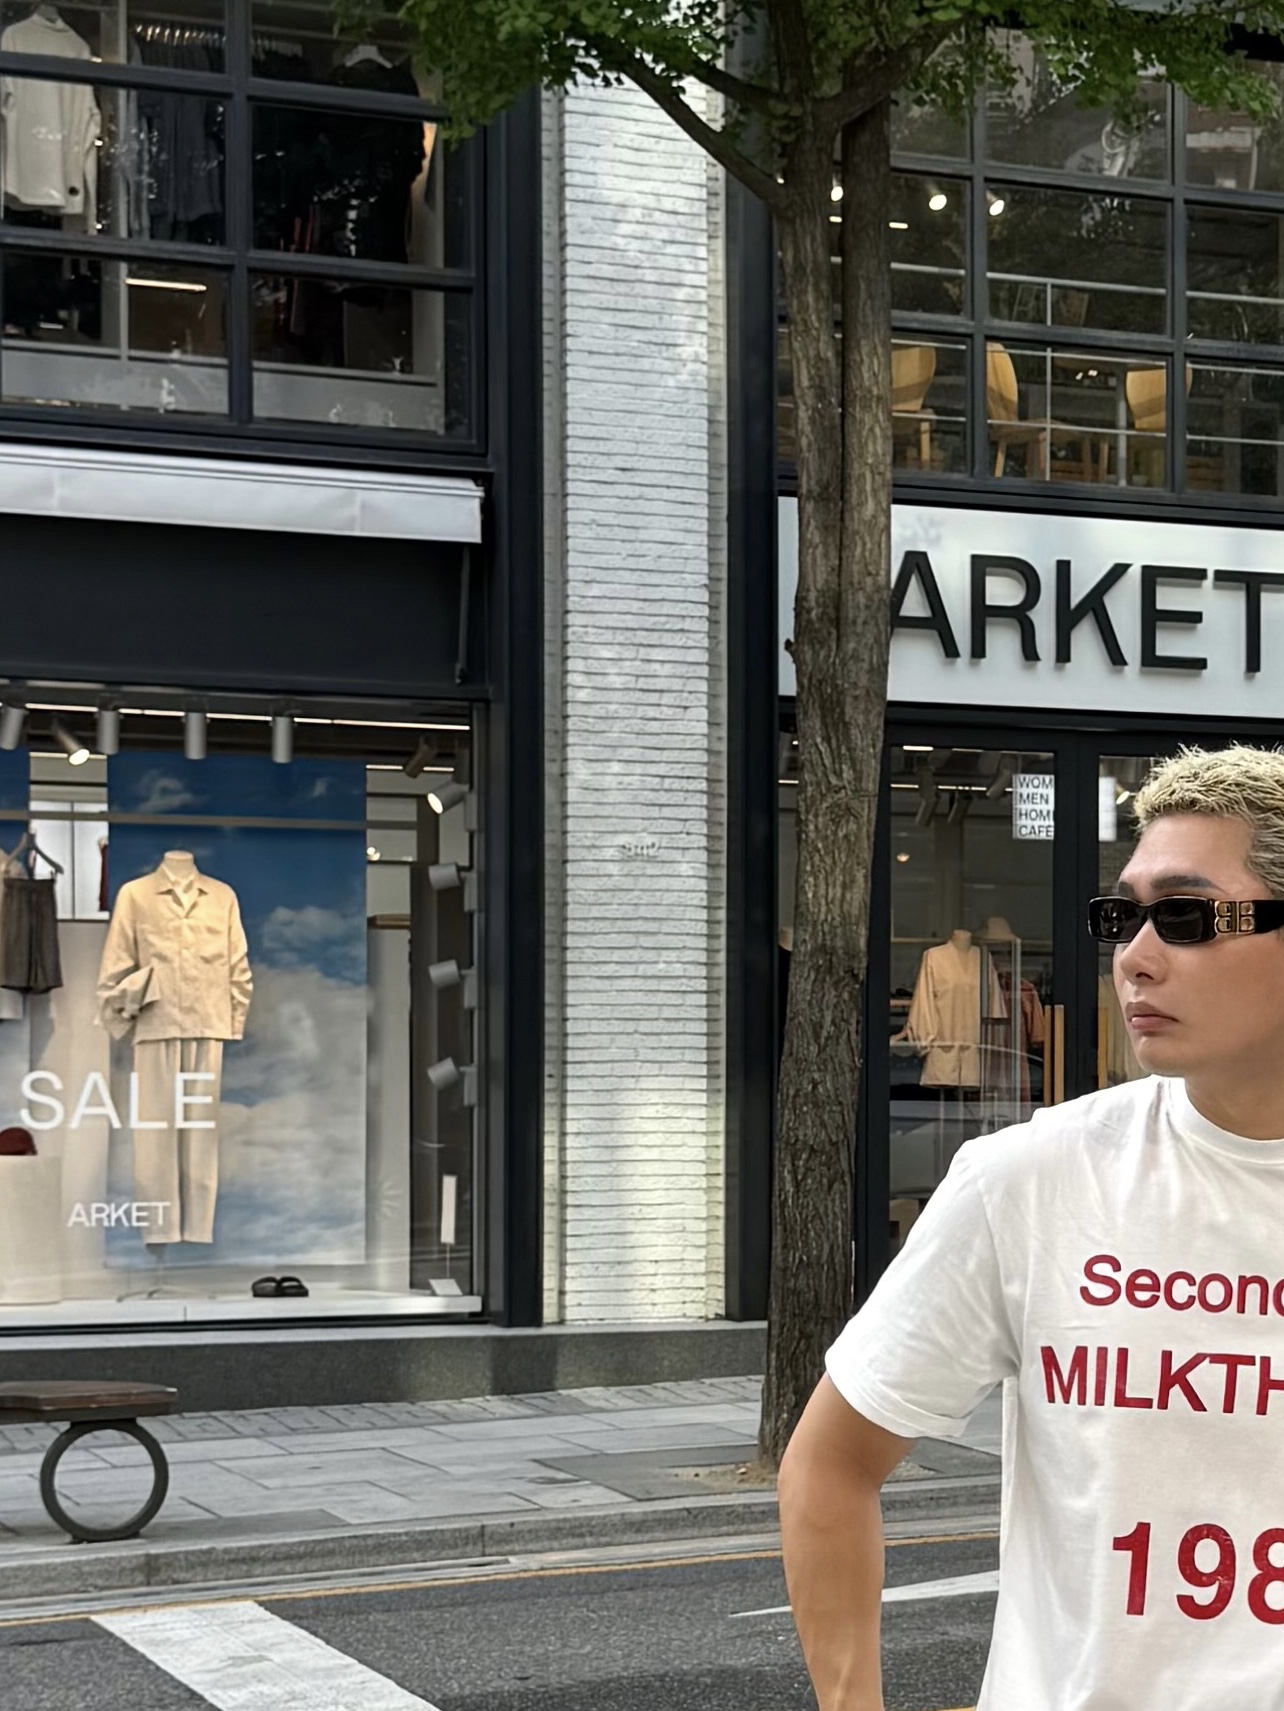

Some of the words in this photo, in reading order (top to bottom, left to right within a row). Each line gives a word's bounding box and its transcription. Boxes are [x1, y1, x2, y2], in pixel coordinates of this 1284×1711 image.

[1019, 791, 1049, 805] MEN
[1019, 808, 1054, 821] HOM
[19, 1070, 217, 1130] SALE
[66, 1201, 171, 1228] ARKET
